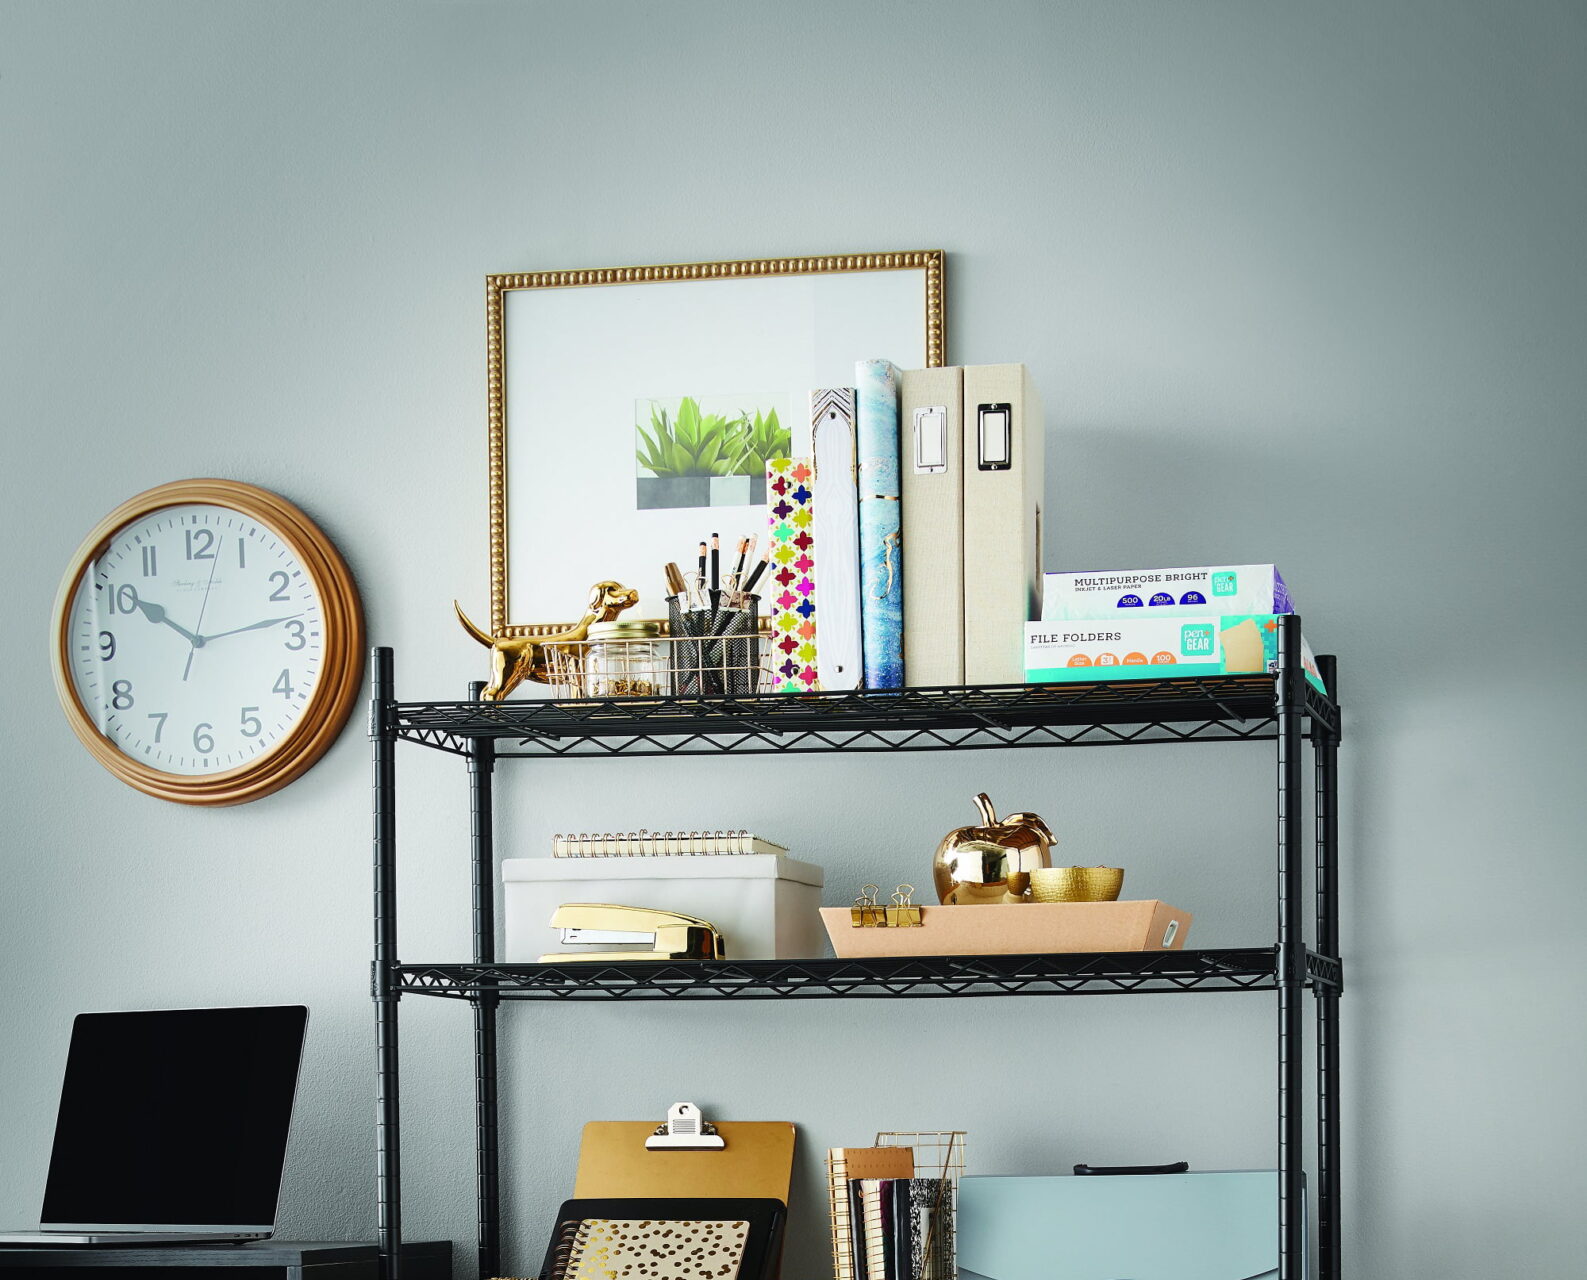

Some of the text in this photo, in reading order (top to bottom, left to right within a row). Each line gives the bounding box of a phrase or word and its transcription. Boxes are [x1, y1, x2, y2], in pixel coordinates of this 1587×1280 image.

[185, 529, 215, 560] 12
[238, 537, 245, 568] 1
[142, 545, 157, 576] 11
[268, 570, 290, 601] 2
[1074, 572, 1208, 586] MULTIPURPOSE BRIGHT
[1216, 582, 1234, 593] GEAR
[108, 583, 138, 614] 10
[1187, 593, 1199, 601] 96
[99, 630, 115, 661] 9
[284, 619, 306, 650] 3
[1031, 632, 1121, 644] FILE FOLDERS
[1186, 638, 1210, 651] GEAR
[112, 679, 134, 710] 8
[272, 668, 294, 699] 4
[148, 712, 168, 743] 7
[240, 706, 262, 737] 5
[193, 723, 214, 754] 6
